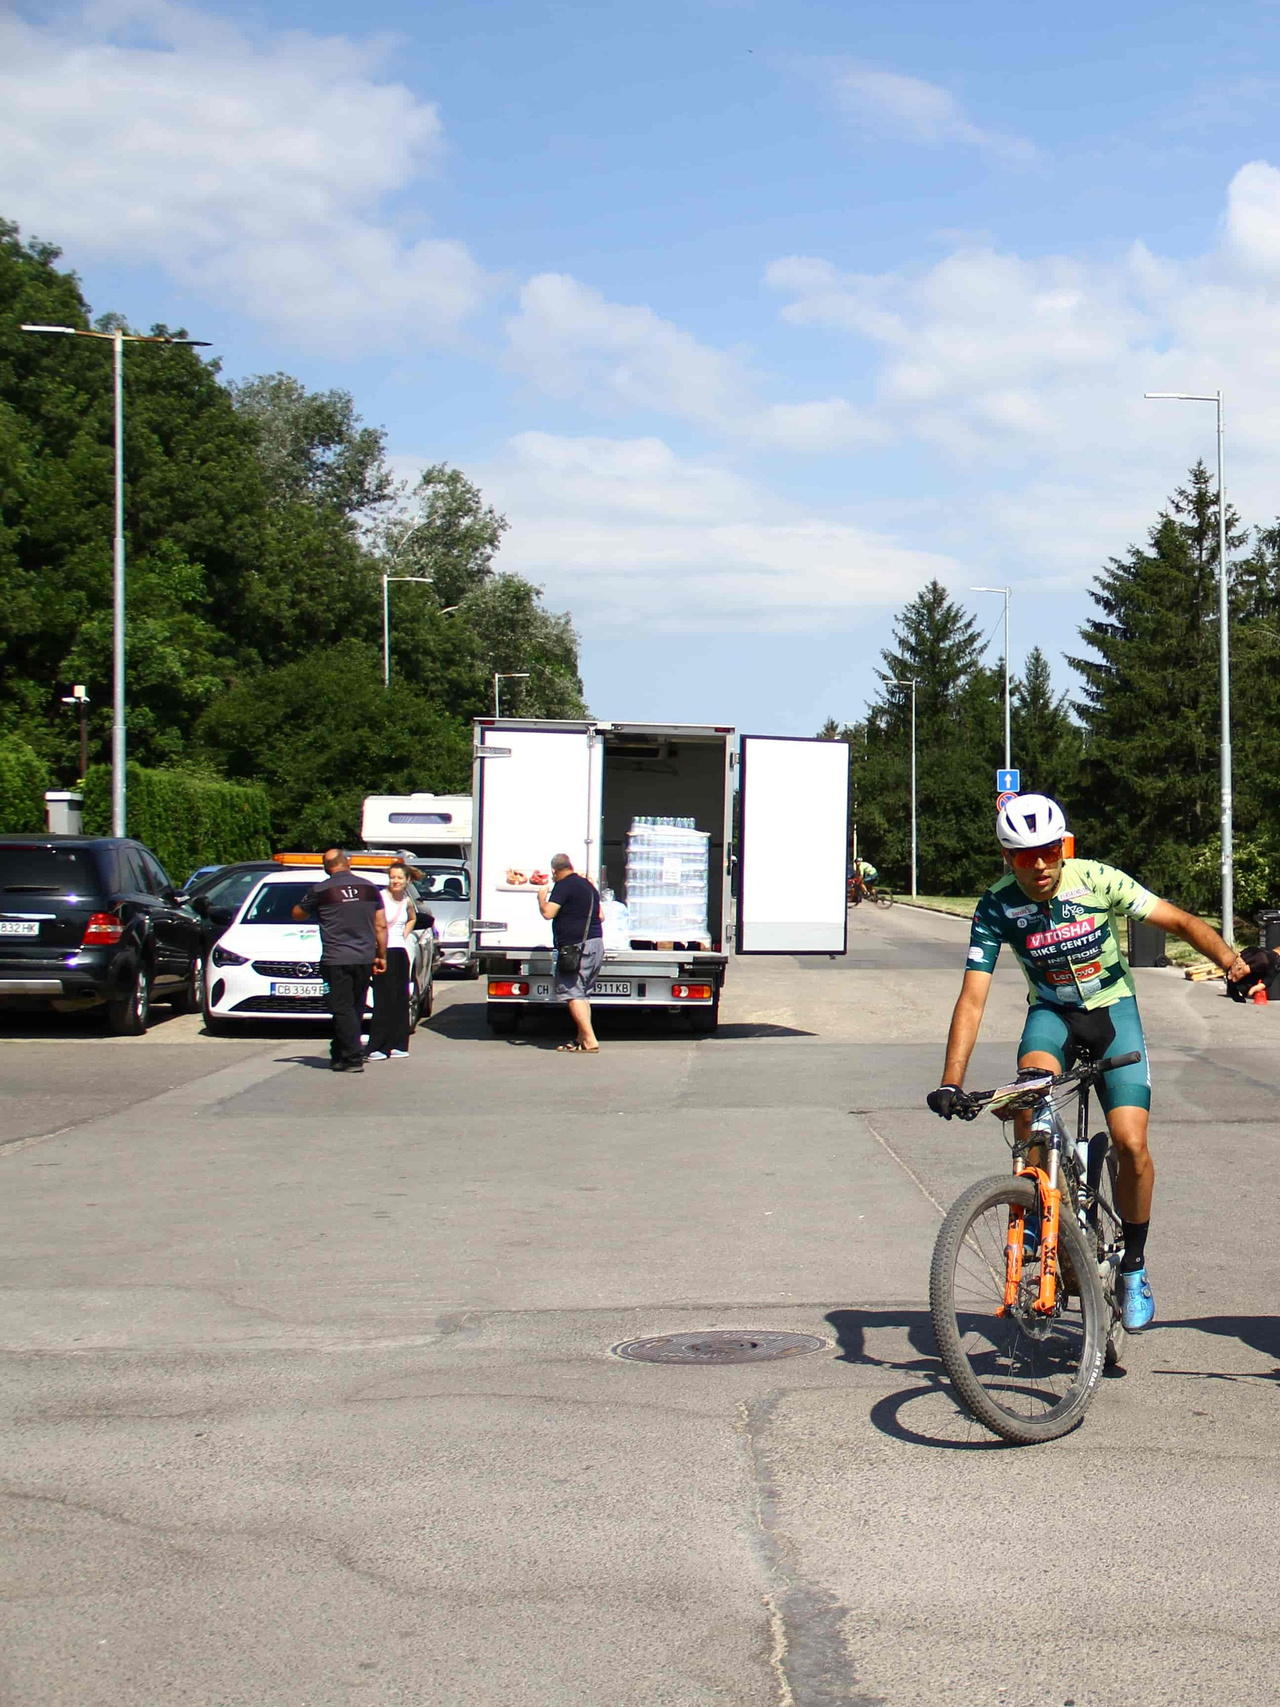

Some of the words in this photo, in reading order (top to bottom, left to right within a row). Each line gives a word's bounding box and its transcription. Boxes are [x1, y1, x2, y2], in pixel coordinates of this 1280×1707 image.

[1030, 921, 1092, 947] VITOSHA
[1030, 945, 1057, 958] BIKE
[1060, 930, 1102, 951] CENTER
[1053, 967, 1095, 980] Lenovo
[292, 985, 317, 995] 3369
[615, 983, 629, 993] KB
